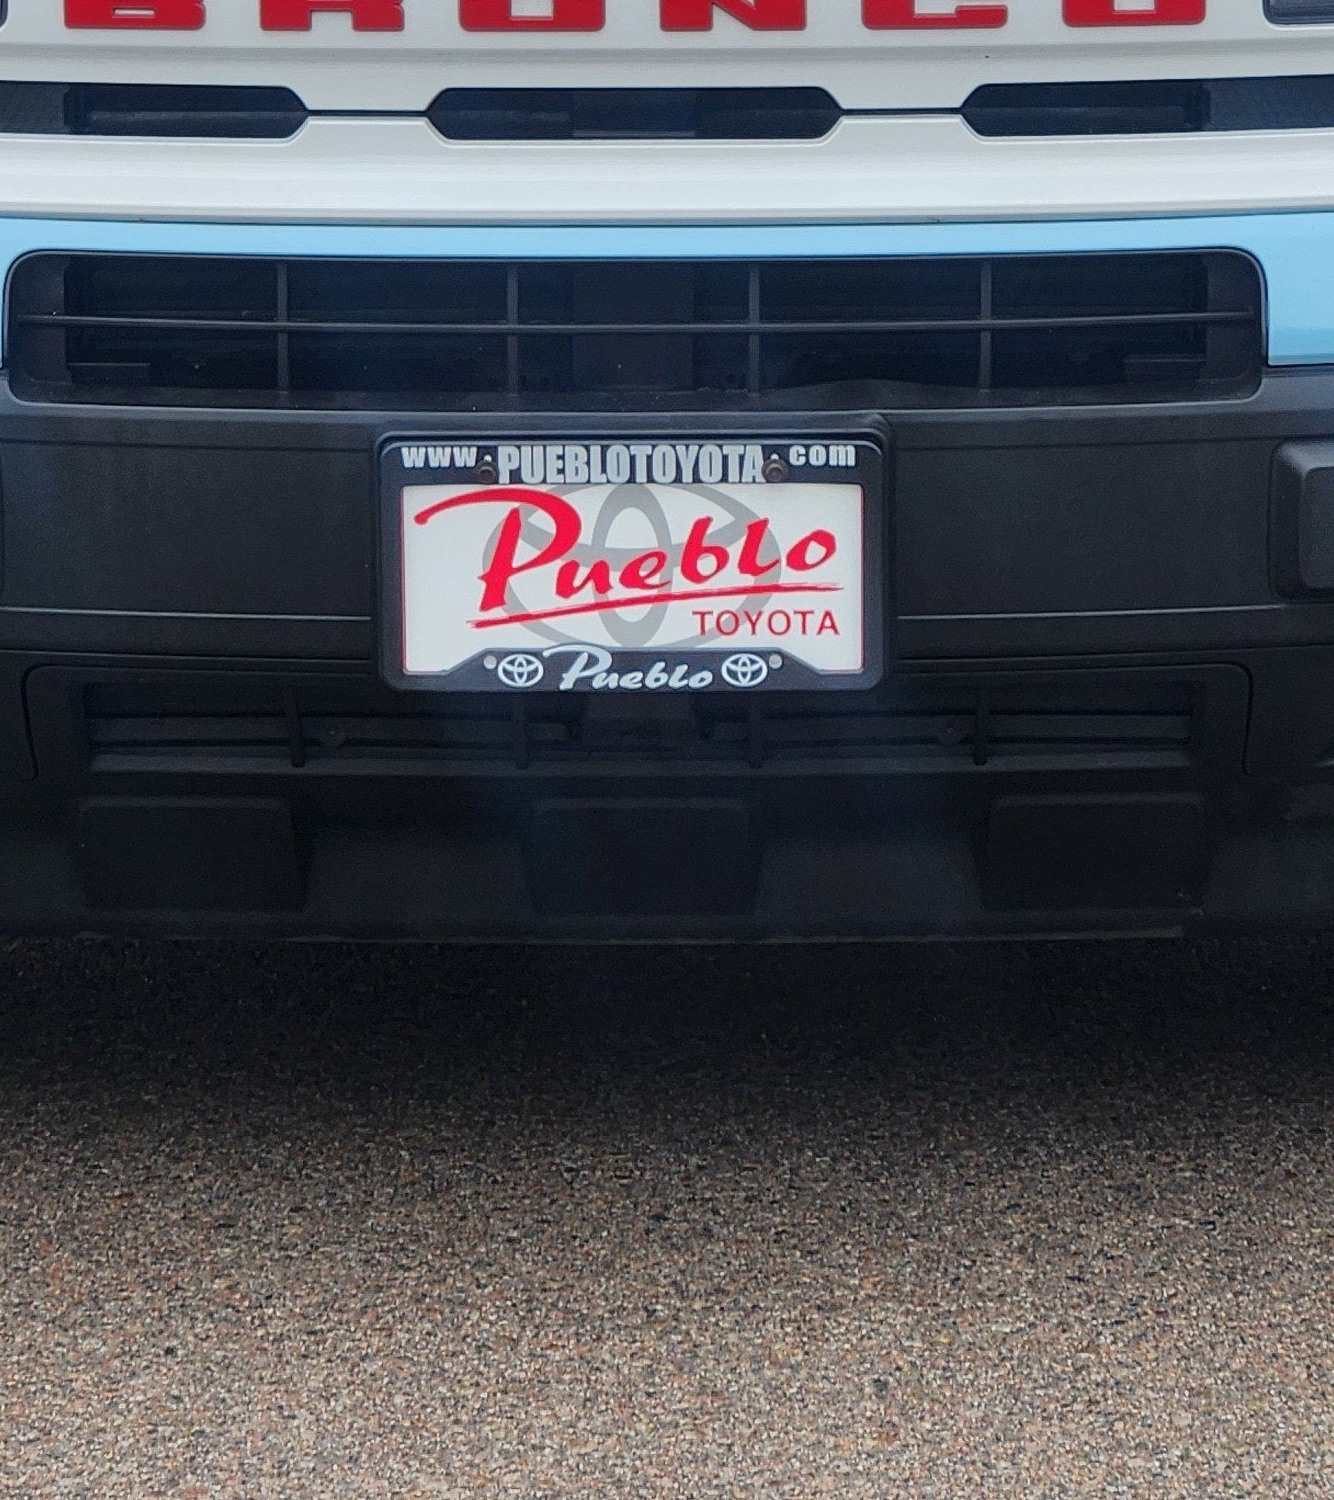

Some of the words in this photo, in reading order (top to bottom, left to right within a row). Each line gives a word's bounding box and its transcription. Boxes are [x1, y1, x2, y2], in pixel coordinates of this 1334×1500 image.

[413, 487, 838, 612] Pueblo
[692, 610, 840, 636] TOYOTA
[543, 644, 714, 691] Pueblo
